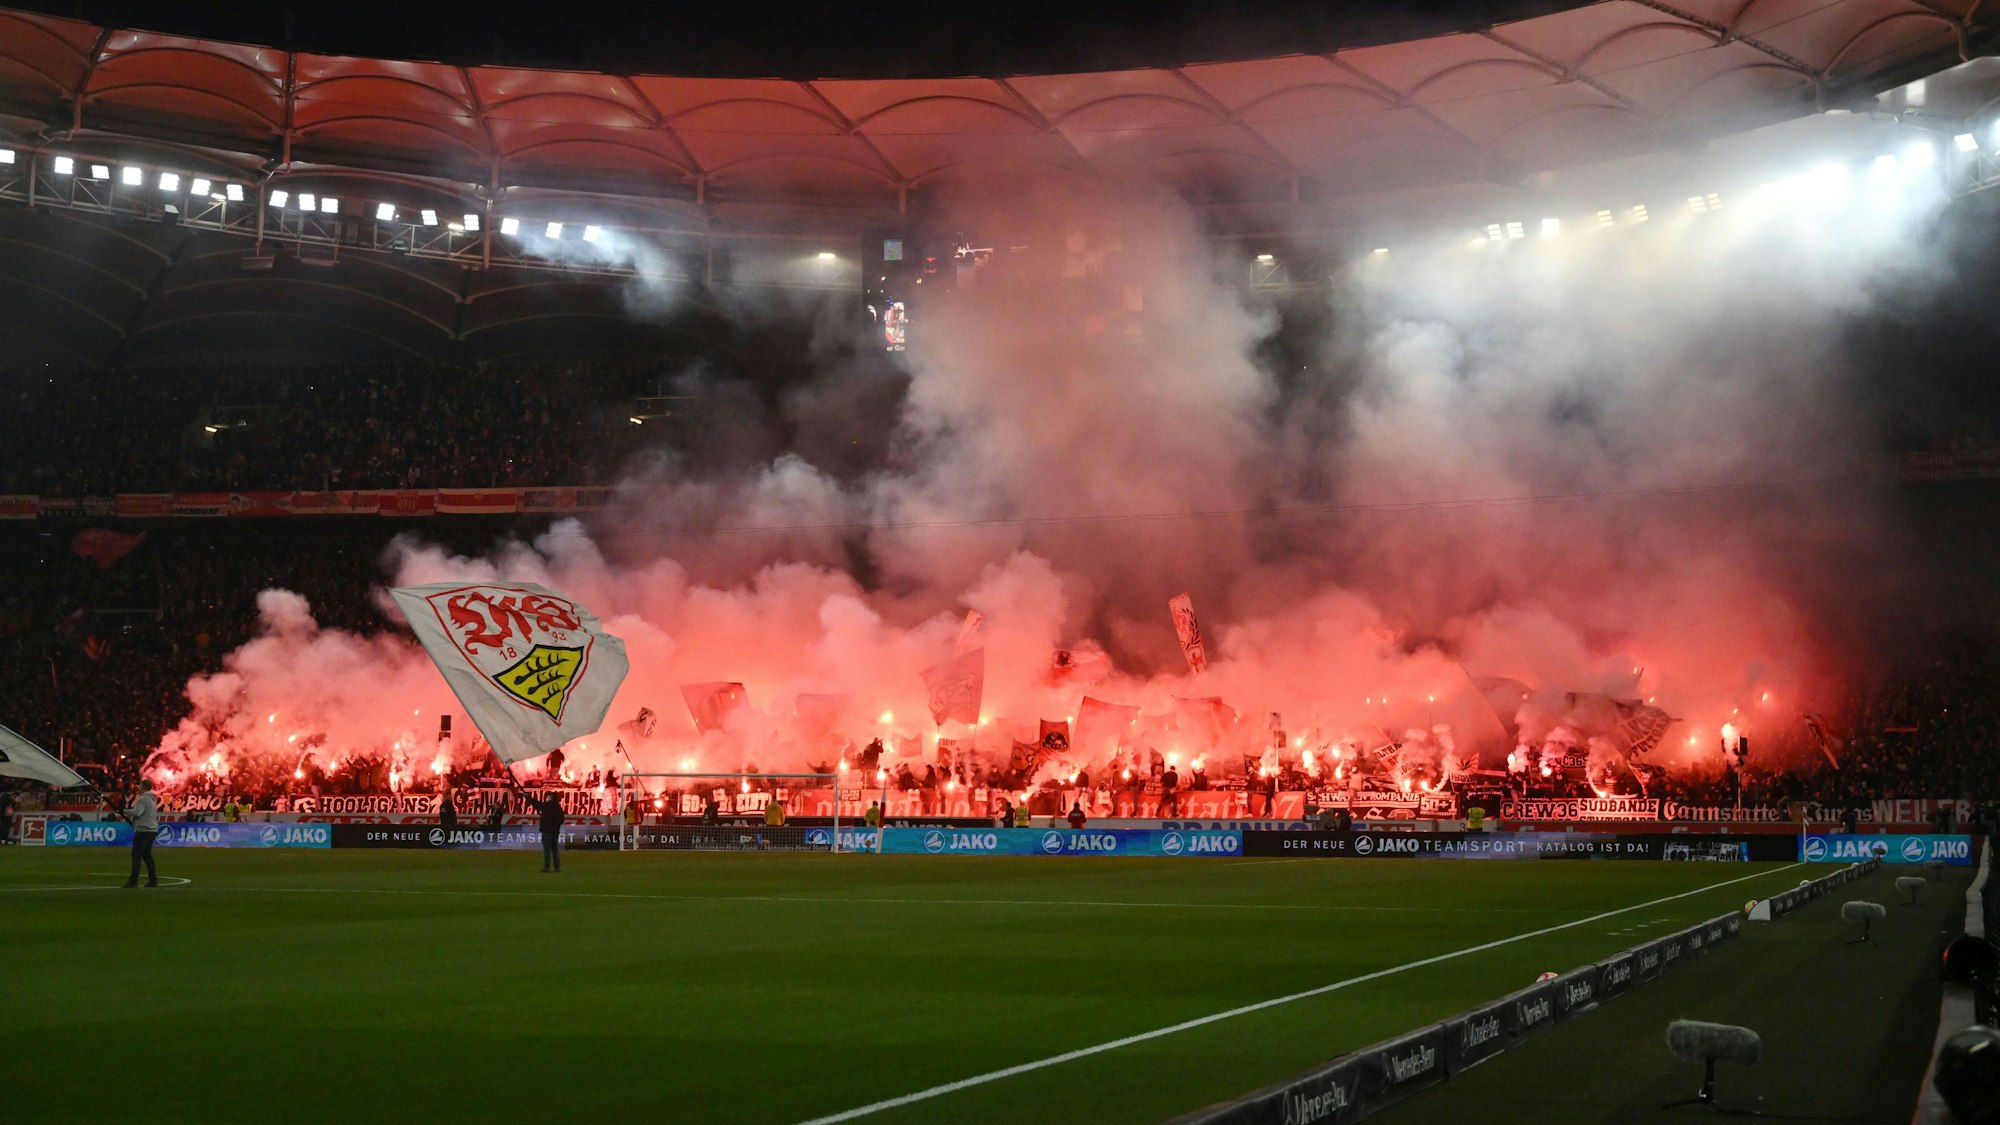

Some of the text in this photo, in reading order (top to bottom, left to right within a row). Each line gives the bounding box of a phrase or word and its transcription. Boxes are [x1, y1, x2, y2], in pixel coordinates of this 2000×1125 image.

[551, 631, 567, 643] 93
[499, 647, 518, 661] 18
[320, 796, 430, 814] HOOLIGANS
[1420, 797, 1458, 812] 50+1
[1663, 801, 1781, 822] Cannstatte
[75, 827, 116, 842] JAKO
[178, 828, 220, 842] JAKO
[284, 828, 327, 843] JAKO
[367, 832, 388, 841] DER
[393, 832, 421, 841] NEUE
[447, 831, 485, 843] JAKO
[488, 832, 576, 843] TEAMSPRT
[661, 835, 680, 844] DA!
[949, 833, 997, 850] JAKO
[1068, 835, 1117, 851] JAKO
[1188, 836, 1238, 852] JAKO
[1283, 838, 1649, 853] DER NEUE JAKO TEAMSPORT KATALOG IST DA!
[1832, 840, 1889, 857] JAKO
[1930, 841, 1969, 857] JAKO
